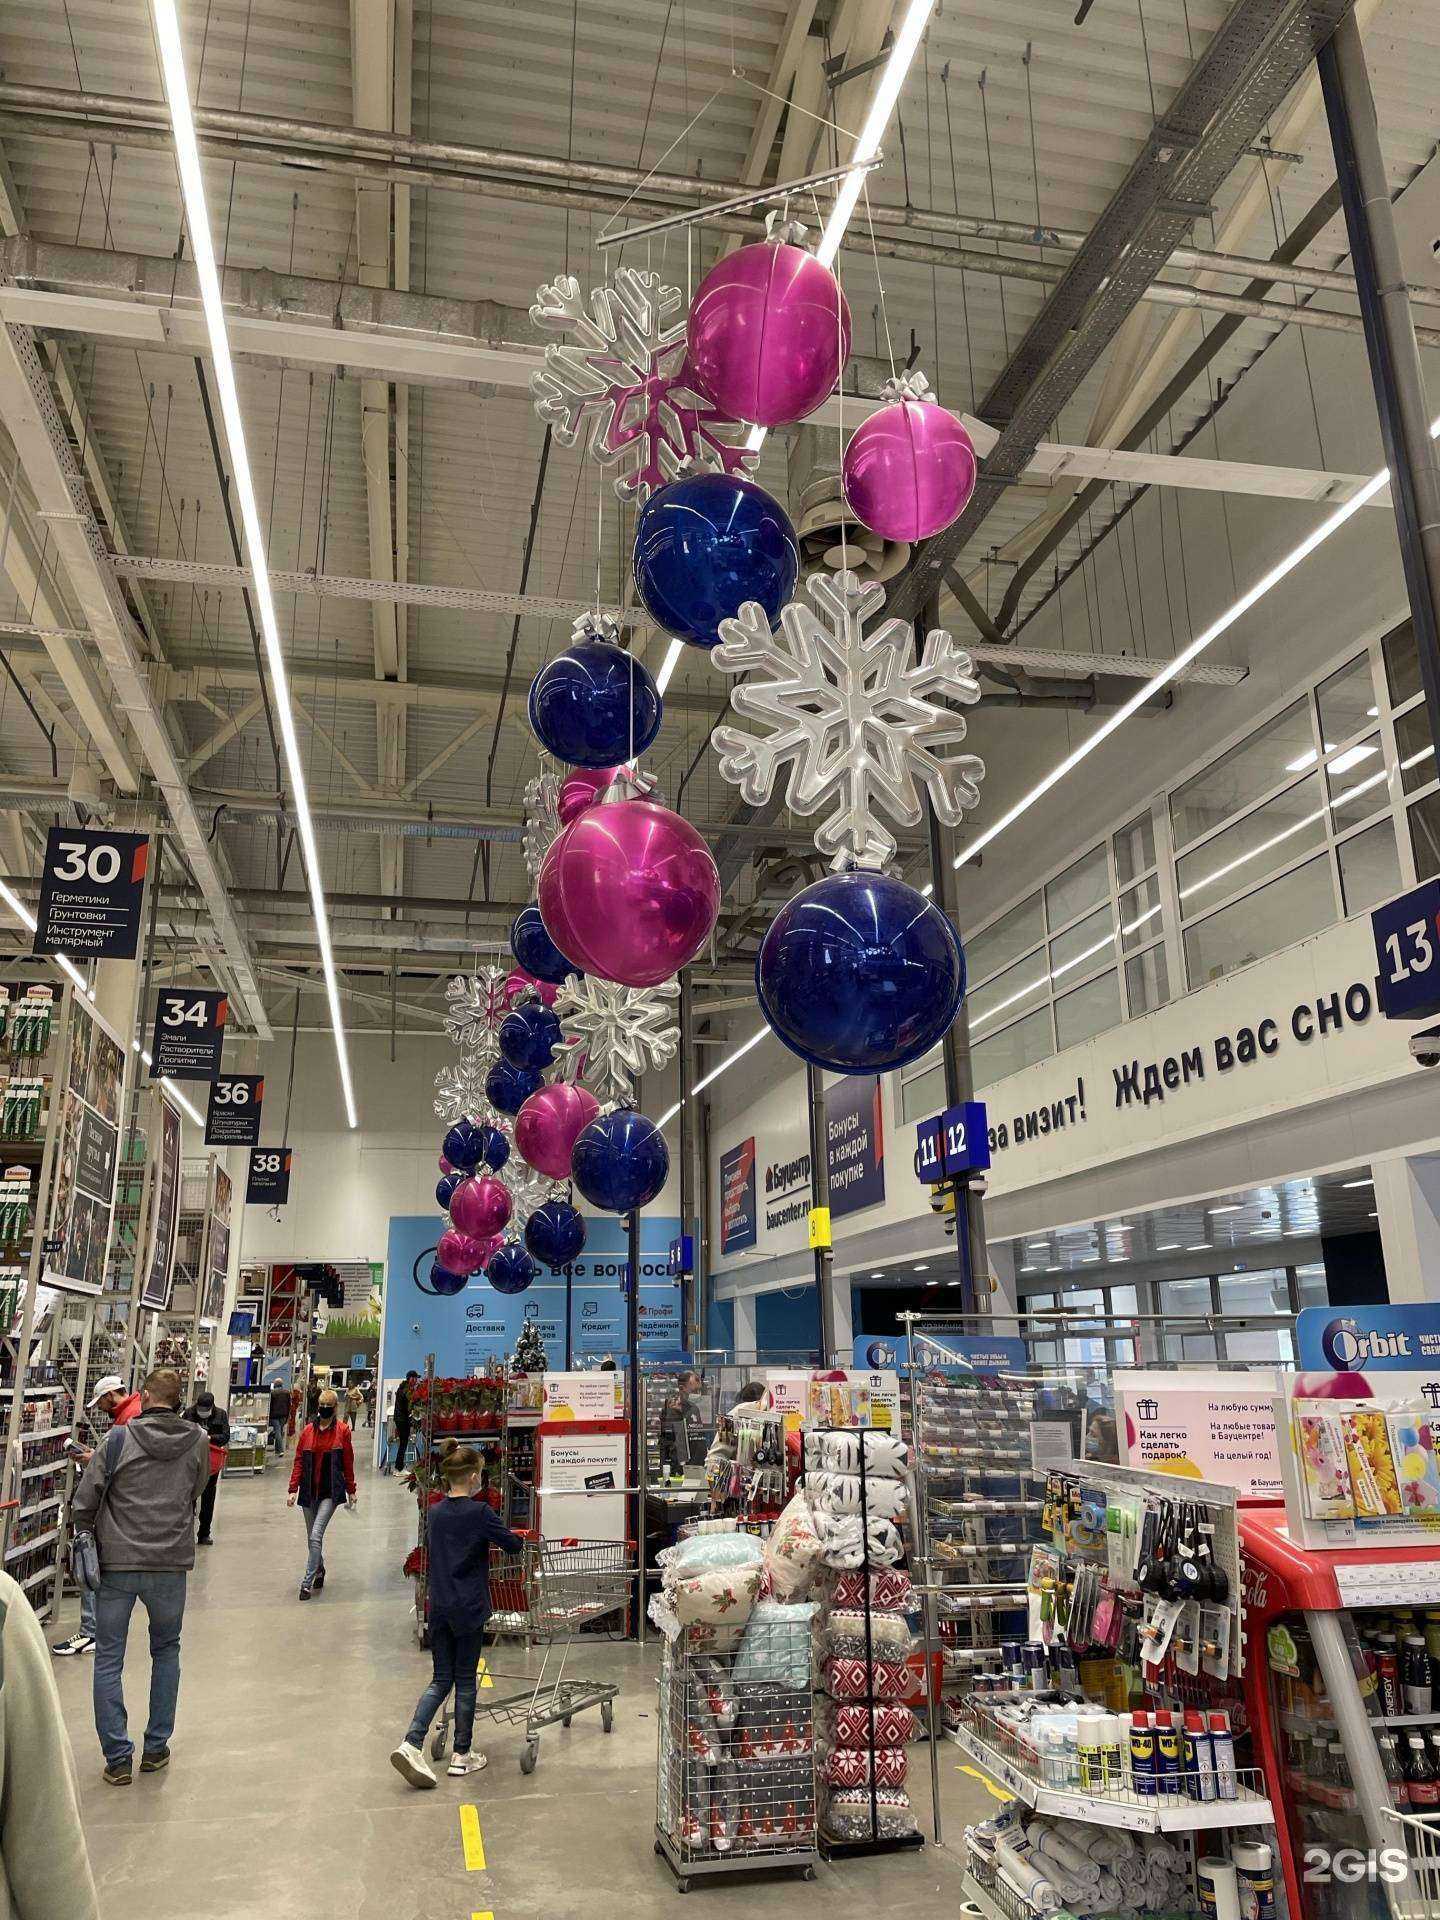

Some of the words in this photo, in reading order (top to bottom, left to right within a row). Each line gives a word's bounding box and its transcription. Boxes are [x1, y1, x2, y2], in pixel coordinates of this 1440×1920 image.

[53, 842, 121, 883] 30
[51, 892, 110, 904] Герметики
[49, 908, 106, 920] Грунтовки
[47, 924, 115, 938] Инструмент
[45, 936, 103, 947] малярный
[1385, 918, 1434, 983] 13
[162, 998, 208, 1027] 34
[161, 1033, 187, 1041] Эмали
[159, 1045, 214, 1055] Растворители
[158, 1055, 197, 1065] Пропитки
[157, 1066, 177, 1074] Лаки
[988, 1123, 1009, 1153] за
[1013, 1077, 1086, 1145] визит!
[1112, 1045, 1205, 1108] Ждем
[1215, 1018, 1279, 1073] вас
[1292, 982, 1372, 1042] сно
[214, 1082, 249, 1105] 36
[828, 1112, 860, 1141] Бонусы
[948, 1122, 967, 1155] 12
[829, 1151, 835, 1166] в
[835, 1130, 868, 1162] каждой
[921, 1135, 937, 1166] 11
[252, 1154, 281, 1173] 38
[774, 1155, 811, 1191] Бауцентр
[830, 1162, 865, 1191] покупке
[767, 1198, 811, 1230] baucenter.ru
[466, 1324, 505, 1333] Доставка
[582, 1323, 611, 1332] Кредит
[1322, 1318, 1412, 1371] Orbit
[1208, 1403, 1218, 1411] На
[1220, 1403, 1248, 1413] любую
[1210, 1422, 1221, 1430] На
[1223, 1422, 1251, 1430] любые
[1140, 1431, 1157, 1439] Как
[1160, 1431, 1187, 1439] легко
[1218, 1432, 1264, 1441] Бауцентре!
[1141, 1441, 1179, 1449] сделать
[587, 1456, 618, 1464] покупке
[1142, 1451, 1187, 1459] подарок?
[1214, 1452, 1224, 1460] На
[1227, 1451, 1252, 1461] целый
[1255, 1452, 1272, 1461] год!
[1384, 1677, 1394, 1717] ENERGY
[1131, 1738, 1151, 1748] WD-40
